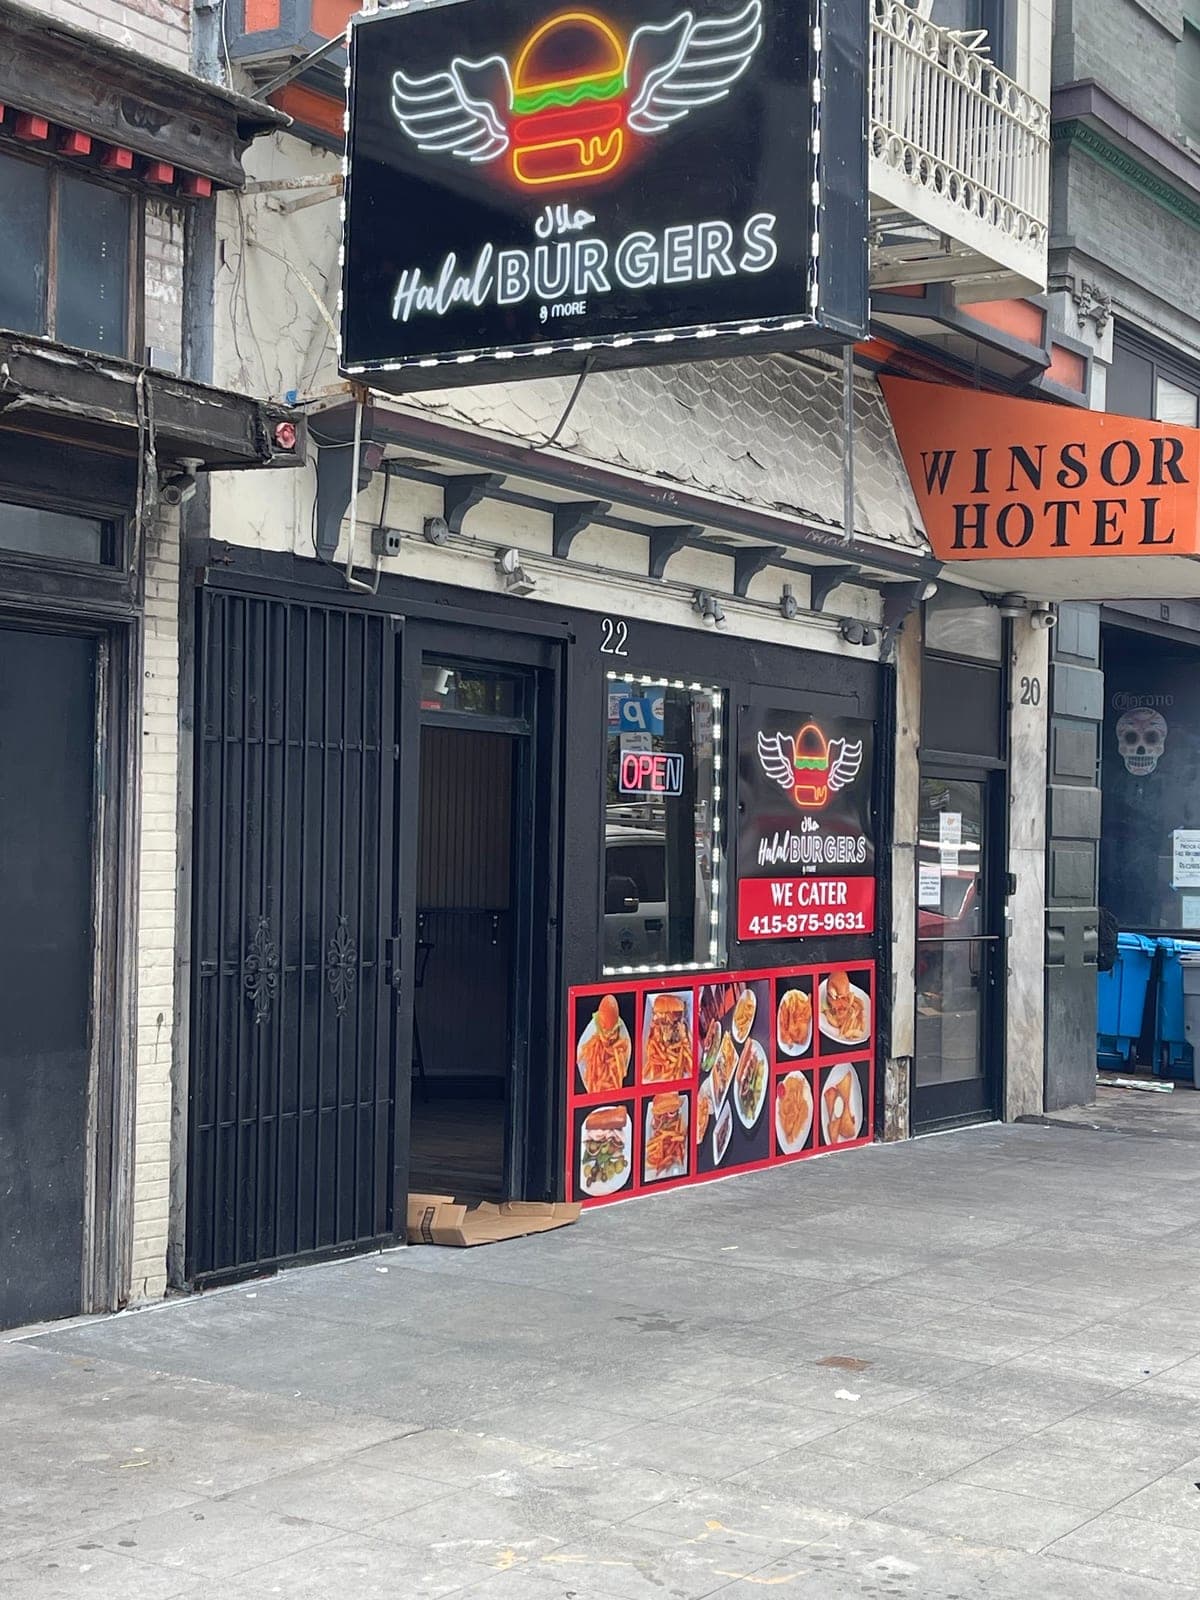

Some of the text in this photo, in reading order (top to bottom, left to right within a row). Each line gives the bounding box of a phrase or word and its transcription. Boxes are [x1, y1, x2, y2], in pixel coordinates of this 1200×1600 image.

[535, 203, 596, 238] حلال
[392, 213, 777, 322] Halal BURGERS
[551, 301, 586, 317] MORE
[920, 437, 1190, 496] WINSOR
[950, 498, 1175, 549] HOTEL
[600, 618, 628, 656] 22
[1020, 676, 1041, 706] 20
[623, 754, 681, 791] OPEN
[758, 830, 866, 866] Halal BURGERS
[771, 881, 848, 907] WE CATER
[749, 911, 866, 935] 415-875-9631
